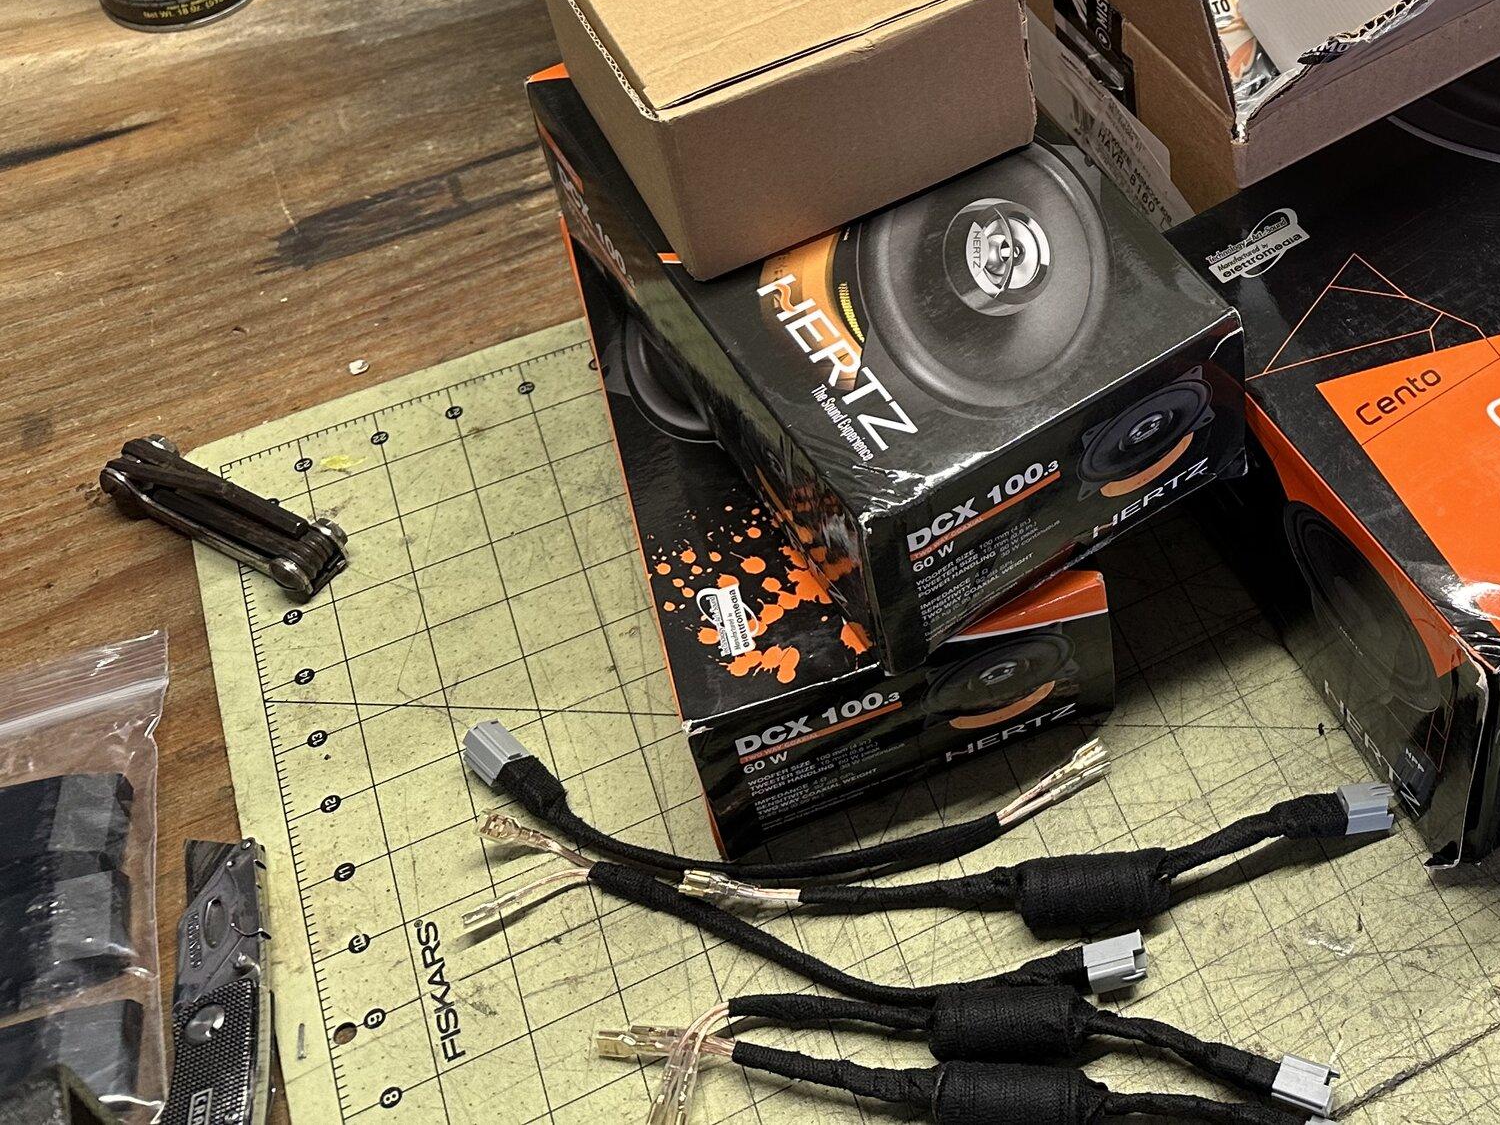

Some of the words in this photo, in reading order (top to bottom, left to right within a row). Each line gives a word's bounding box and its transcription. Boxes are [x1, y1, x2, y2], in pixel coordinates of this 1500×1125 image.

[1205, 238, 1247, 264] Technology
[1263, 216, 1288, 235] Sound
[1217, 245, 1261, 272] Manufactured
[1222, 233, 1303, 278] elettromedia
[757, 273, 919, 452] HERTZ
[1356, 366, 1443, 429] Cento
[811, 383, 829, 403] The
[821, 397, 845, 426] Sound
[837, 417, 875, 463] Experience
[906, 496, 979, 554] DCX
[986, 459, 1060, 505] 100.3
[1092, 456, 1209, 539] HERTZ
[911, 555, 935, 573] 60
[937, 540, 955, 559] W
[915, 561, 955, 586] WOOFER
[955, 548, 976, 564] SIZE
[916, 564, 960, 592] TWEETER
[959, 553, 980, 570] SIZE
[917, 577, 951, 599] POWER
[951, 550, 997, 581] HANDLING
[919, 577, 972, 610] IMPEDANCE
[921, 583, 973, 616] SENSITIVITY
[922, 608, 943, 622] TWO
[943, 595, 964, 611] WAY
[964, 573, 1001, 598] COAXIAL
[1000, 552, 1034, 575] WEIGHT
[729, 588, 751, 648] elettromedia
[734, 714, 814, 756] DCX
[821, 691, 901, 726] 100.3
[945, 702, 1077, 763] HERTZ
[743, 760, 766, 774] 60
[769, 751, 789, 766] W
[1324, 678, 1421, 817] HERTZ
[747, 767, 790, 786] WOOFER
[749, 771, 795, 792] TWEETER
[751, 780, 787, 797] POWER
[787, 763, 835, 784] HANDLING
[754, 782, 810, 807] IMPEDANCE
[757, 806, 780, 817] TWO
[800, 782, 842, 799] COAXIAL
[418, 920, 466, 1063] FISKARS
